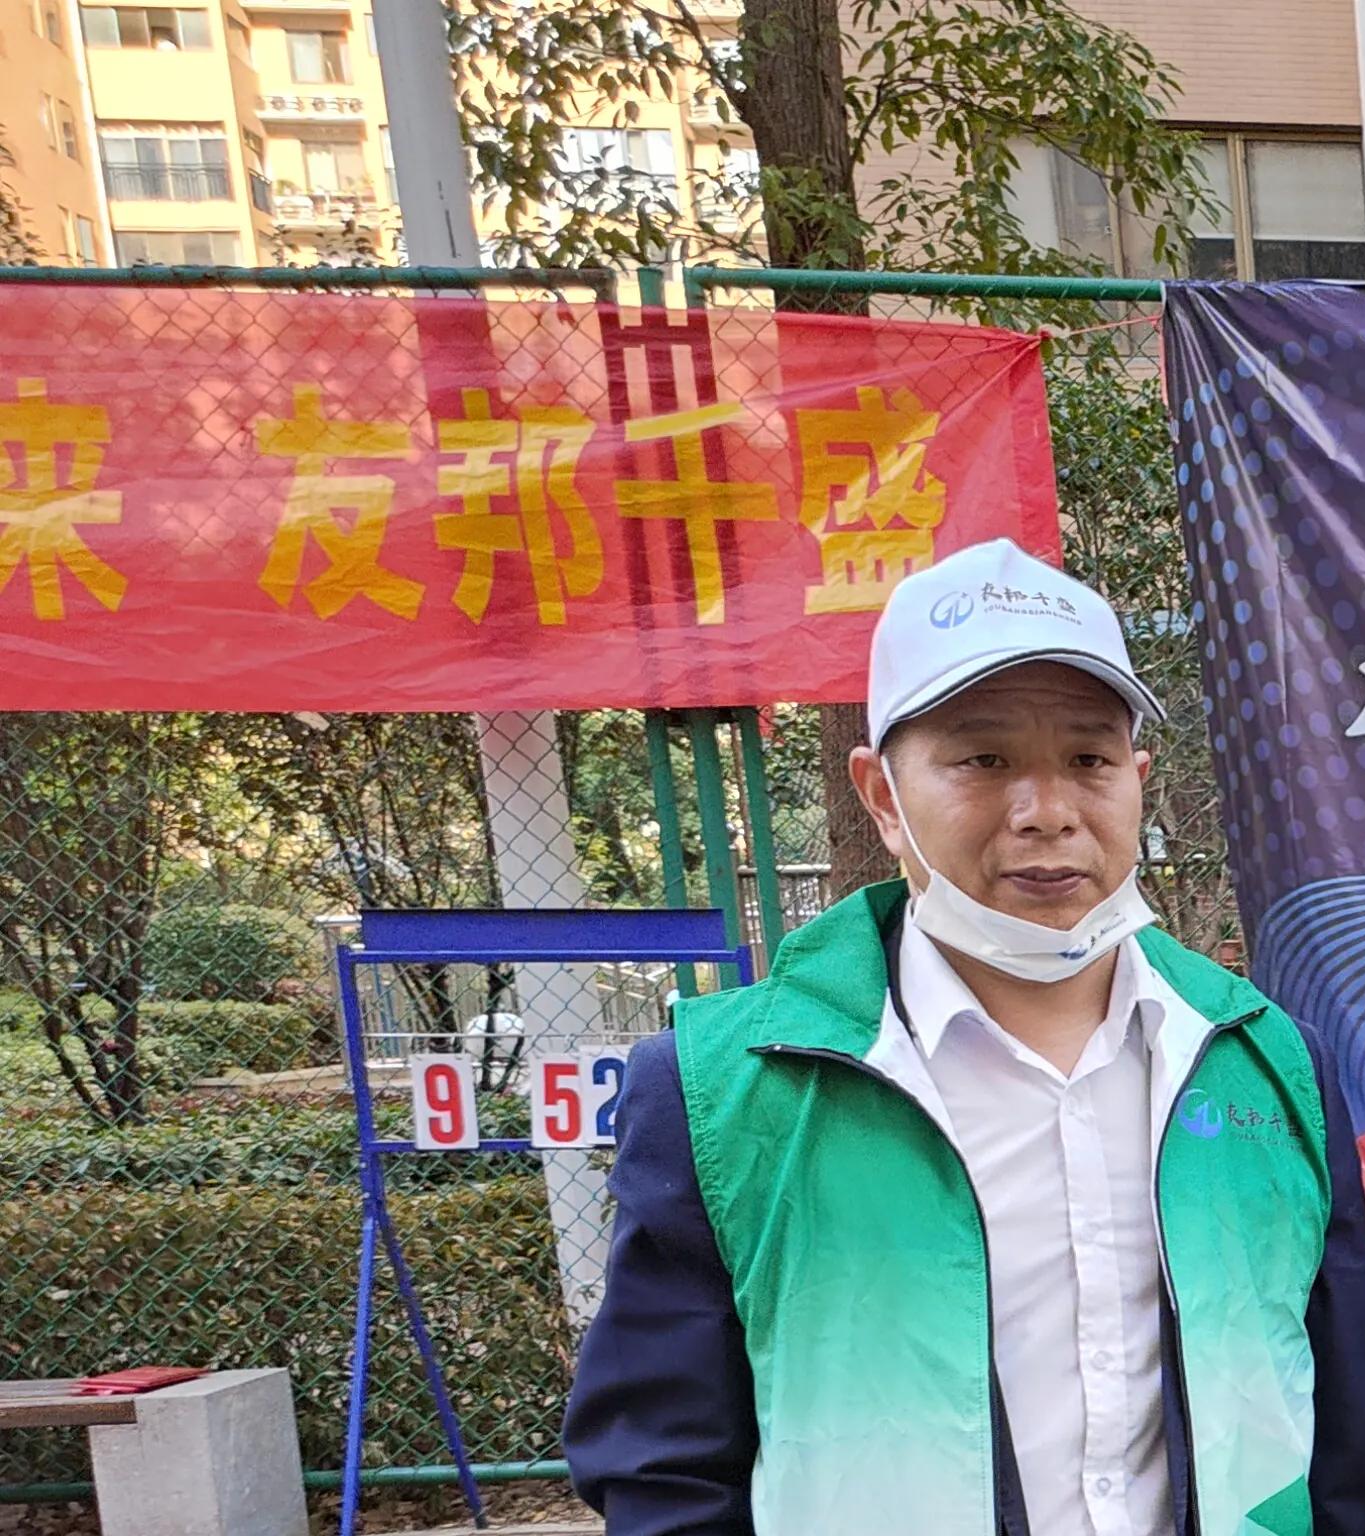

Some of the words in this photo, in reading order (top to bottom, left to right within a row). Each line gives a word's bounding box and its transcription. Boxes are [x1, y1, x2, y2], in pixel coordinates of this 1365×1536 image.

[256, 383, 946, 626] 友邦千盛
[423, 1062, 466, 1145] 9
[543, 1062, 583, 1144] 5
[591, 1056, 627, 1137] 2
